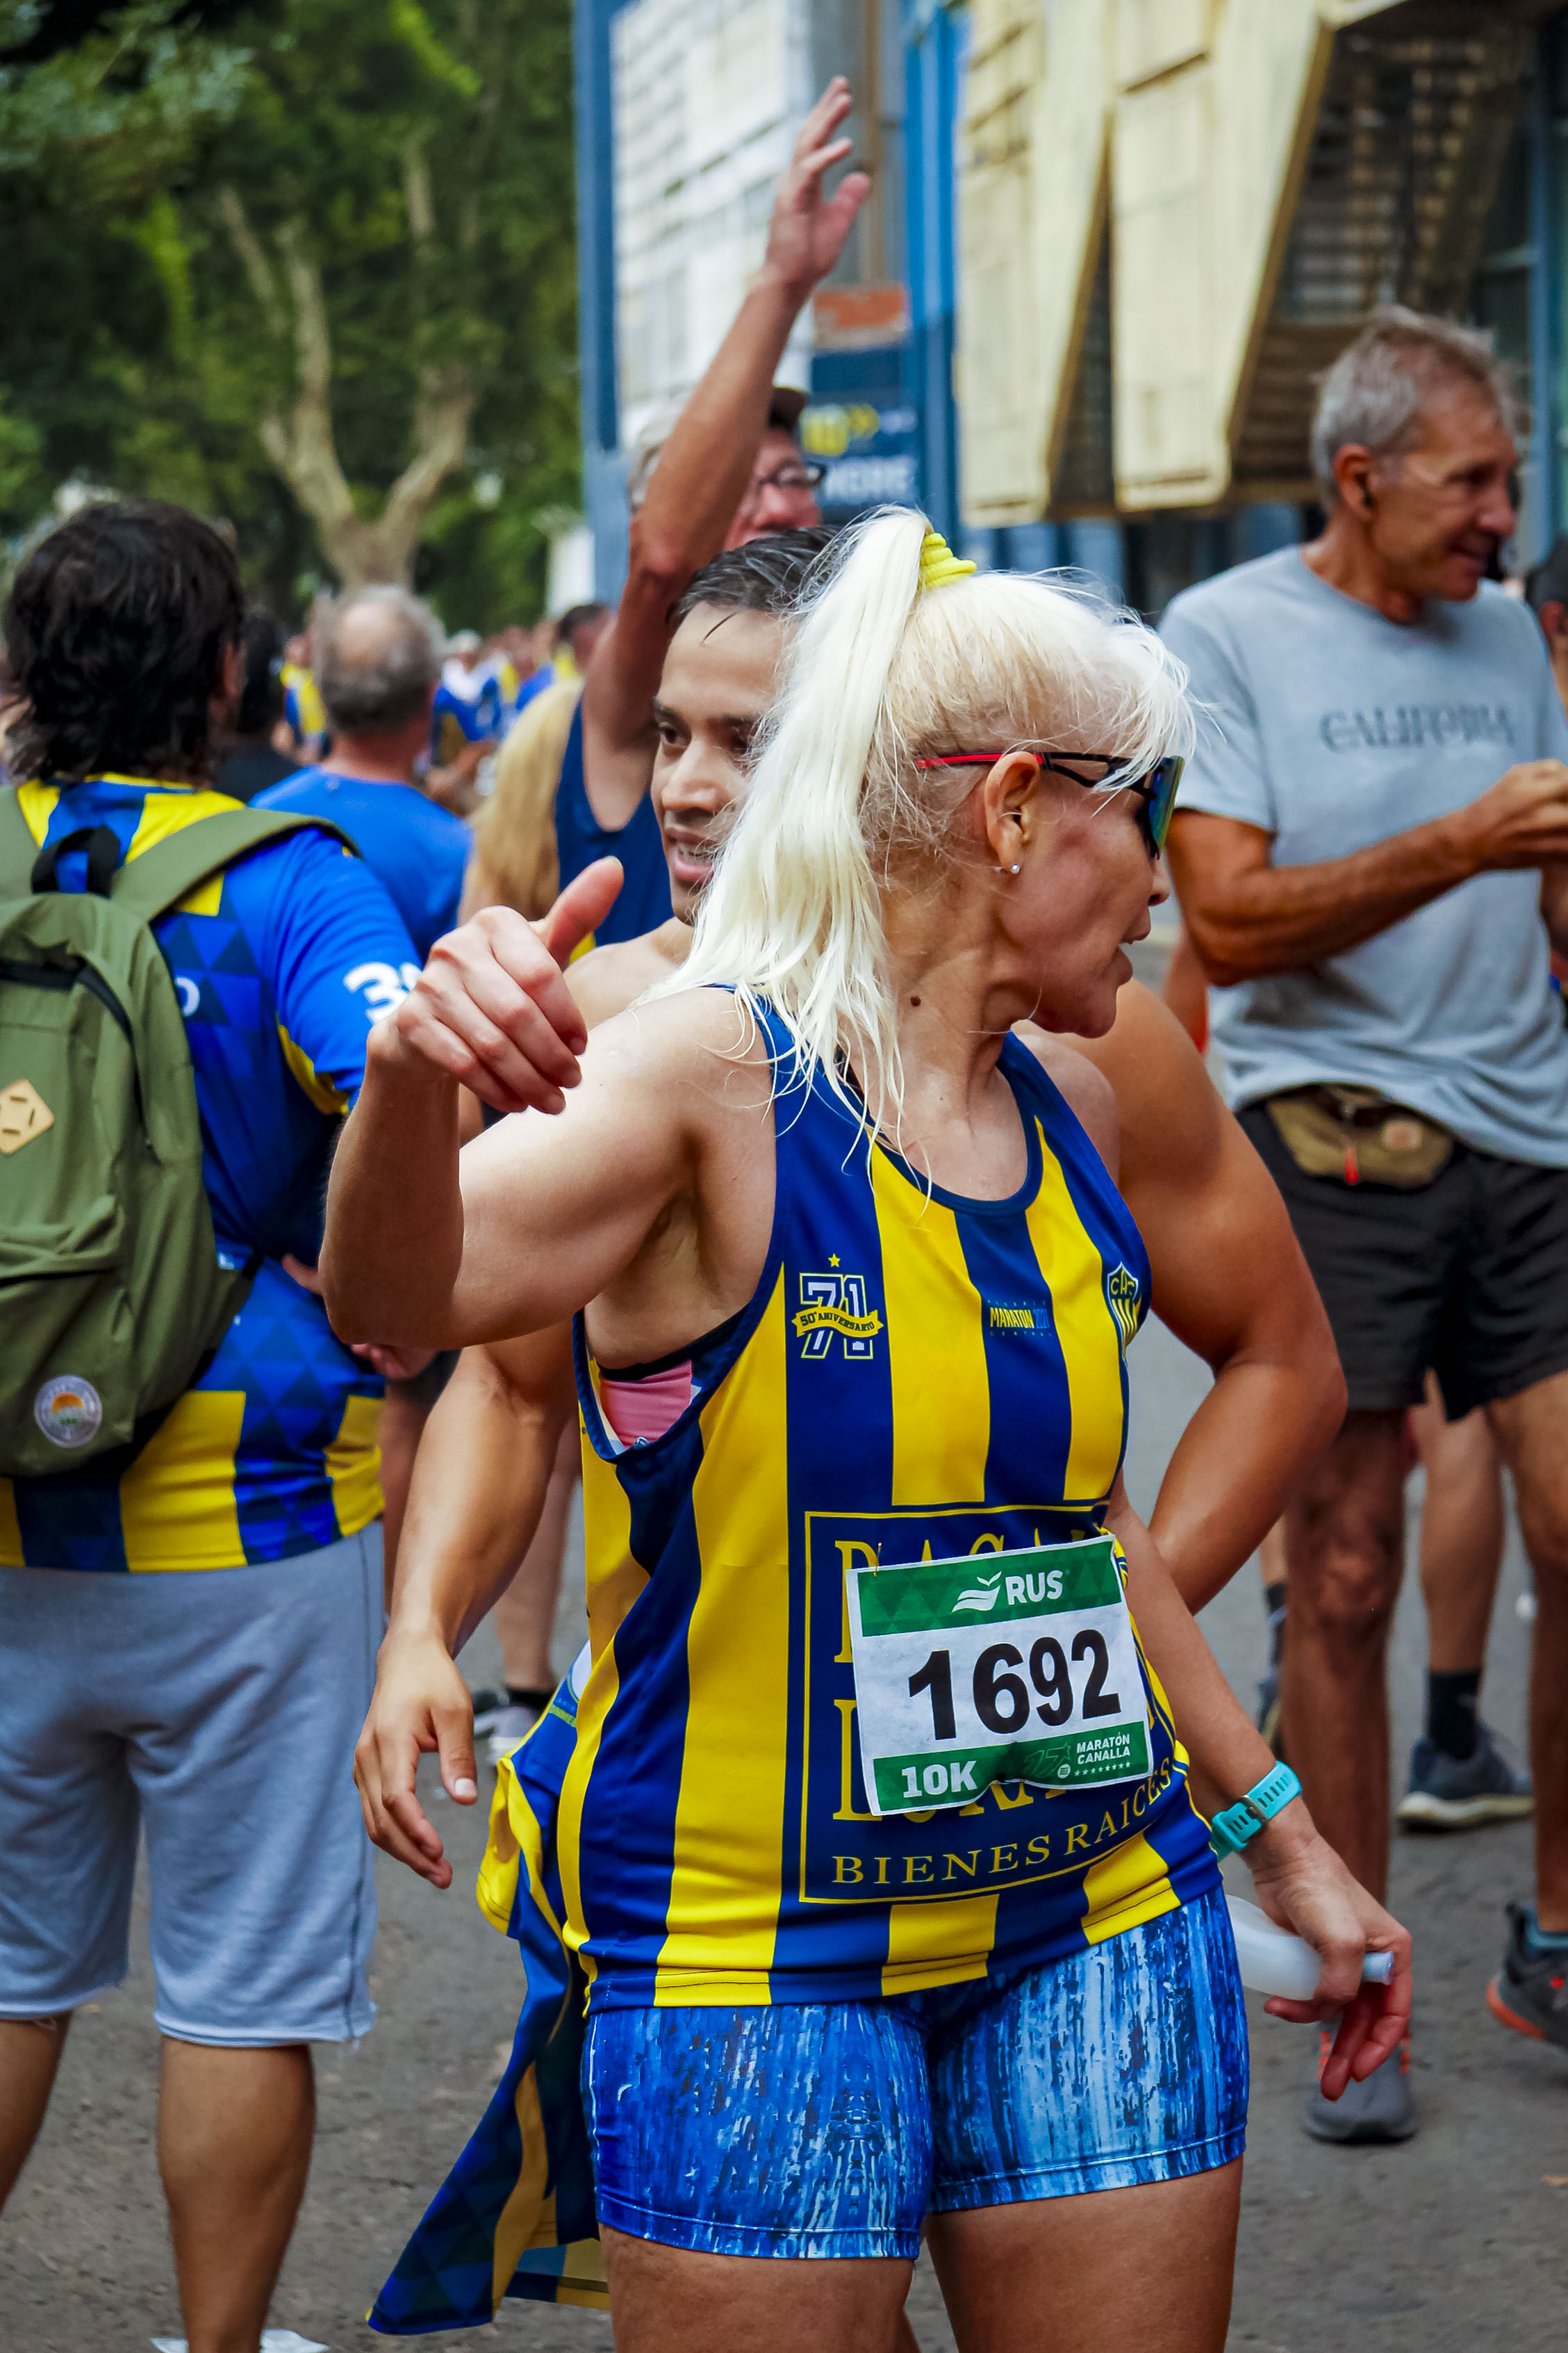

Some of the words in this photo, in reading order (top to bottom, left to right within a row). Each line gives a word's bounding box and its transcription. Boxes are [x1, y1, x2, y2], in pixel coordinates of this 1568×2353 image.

[799, 1272, 873, 1359] 71
[818, 1312, 875, 1331] ANIVERSARIO
[990, 1306, 1034, 1329] MARATON
[1005, 1569, 1064, 1606] RUS
[908, 1629, 1122, 1741] 1692
[1077, 1732, 1130, 1753] MARATÓN
[1078, 1746, 1131, 1764] CANALLA
[902, 1760, 978, 1798] 10K
[832, 1835, 1050, 1884] BIENES
[1064, 1757, 1171, 1855] RAICES
